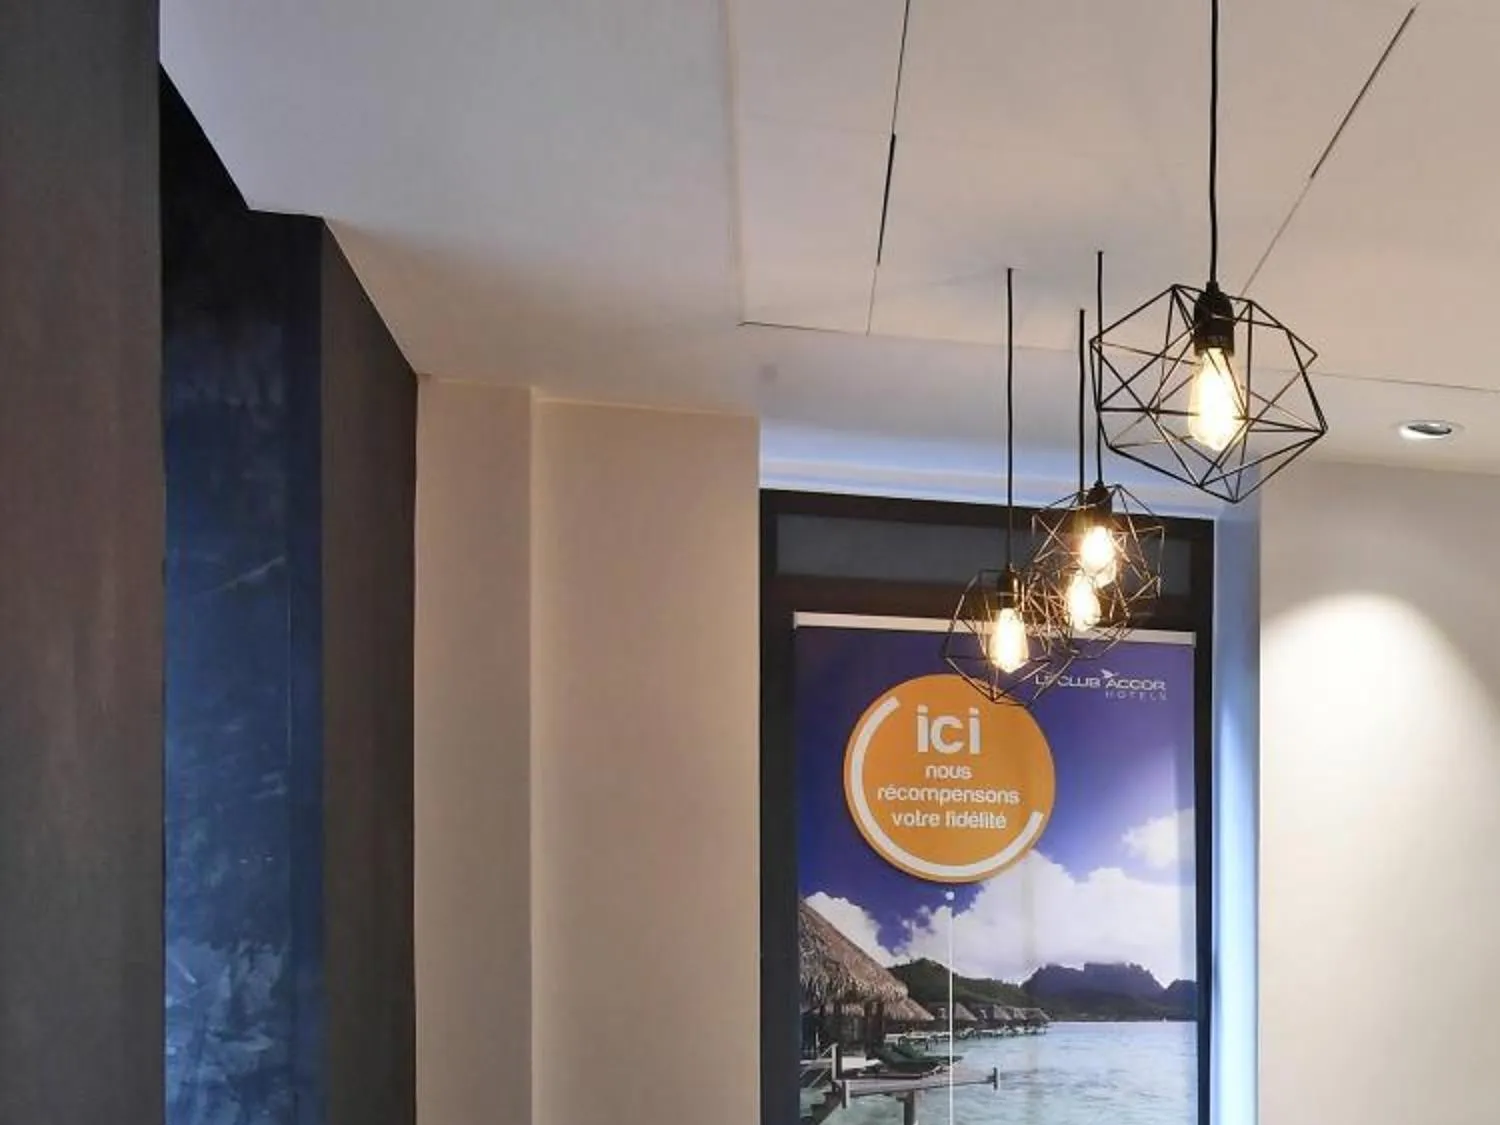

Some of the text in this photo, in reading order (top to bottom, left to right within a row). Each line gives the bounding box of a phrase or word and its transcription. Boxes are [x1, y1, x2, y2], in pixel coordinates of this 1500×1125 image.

[1057, 674, 1101, 688] CLUB
[1105, 678, 1167, 691] ACCOR
[916, 705, 981, 755] ici
[925, 763, 973, 780] nous
[877, 783, 1020, 807] récompensons
[892, 809, 1007, 829] votre fidélité
